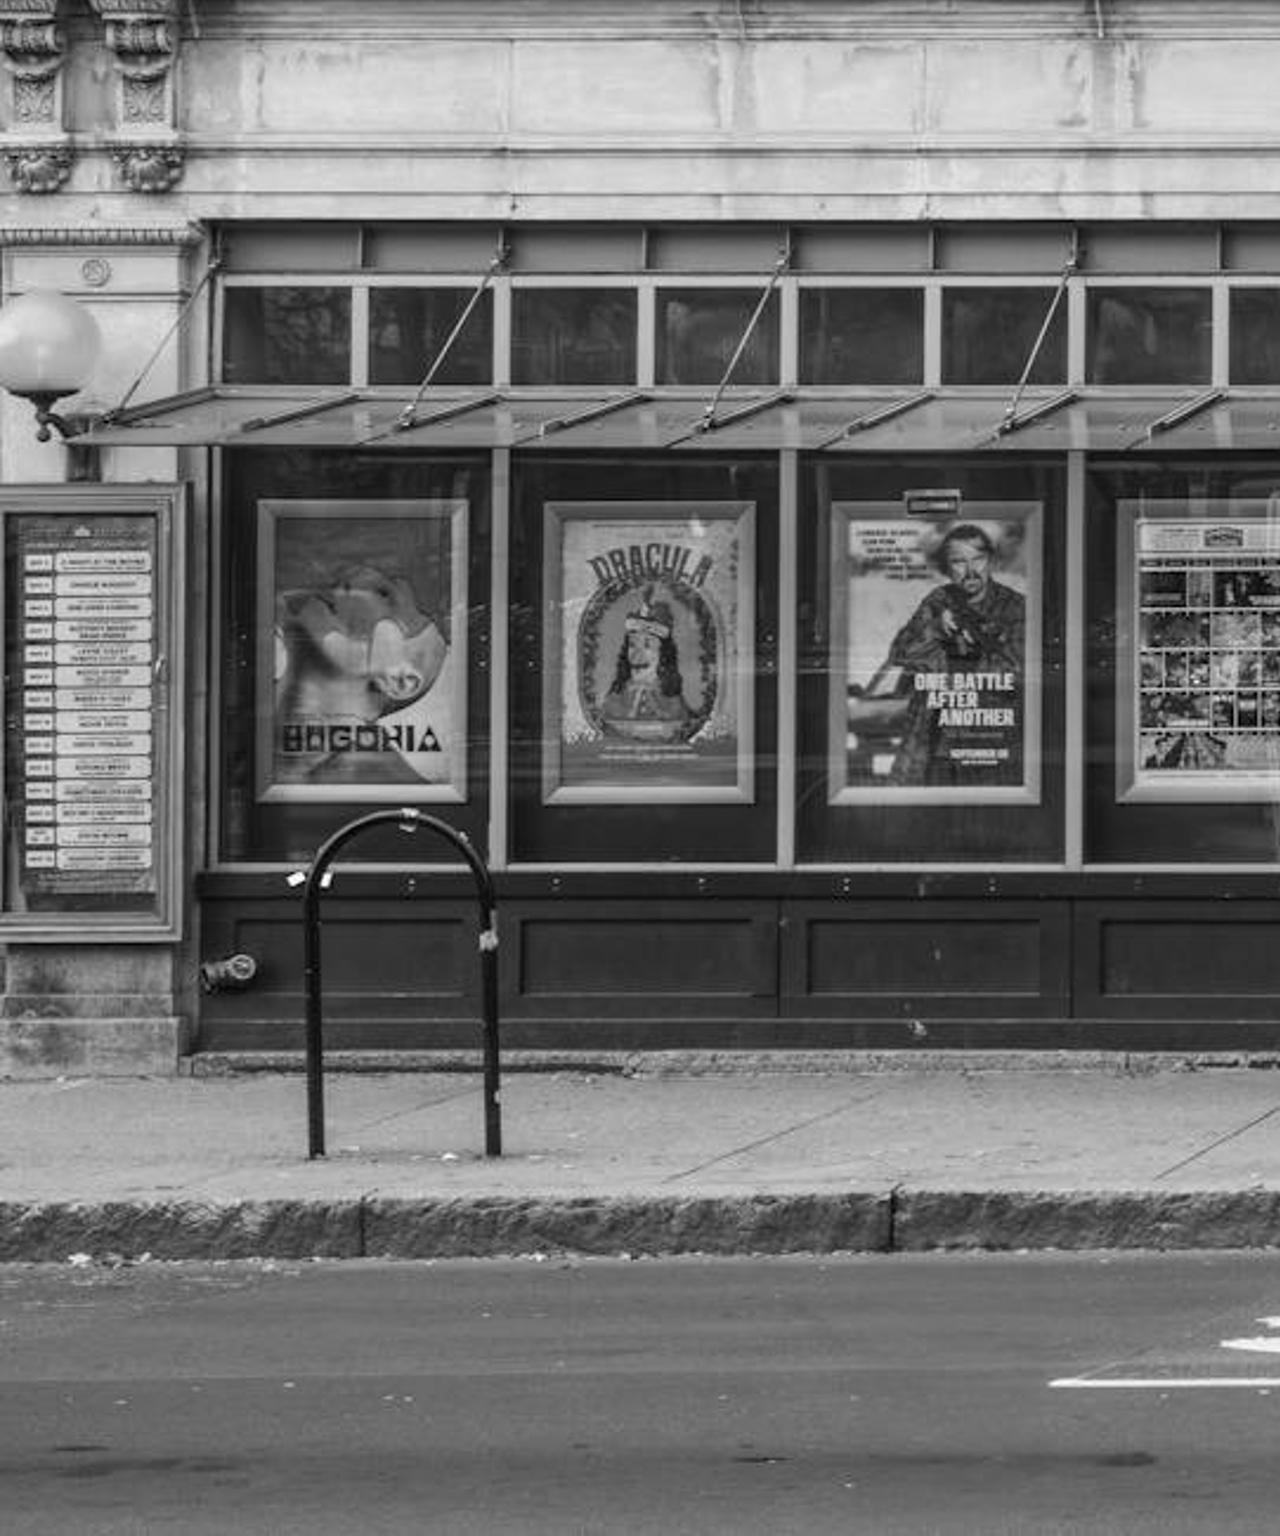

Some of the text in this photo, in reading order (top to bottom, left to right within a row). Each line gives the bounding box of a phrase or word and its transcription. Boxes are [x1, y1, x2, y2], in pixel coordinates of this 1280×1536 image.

[587, 543, 714, 589] DRACULA
[914, 673, 1014, 691] ONE BATTLE
[926, 692, 978, 709] AFTER
[938, 709, 1014, 726] ANOTHER
[283, 725, 442, 752] BUGONIA
